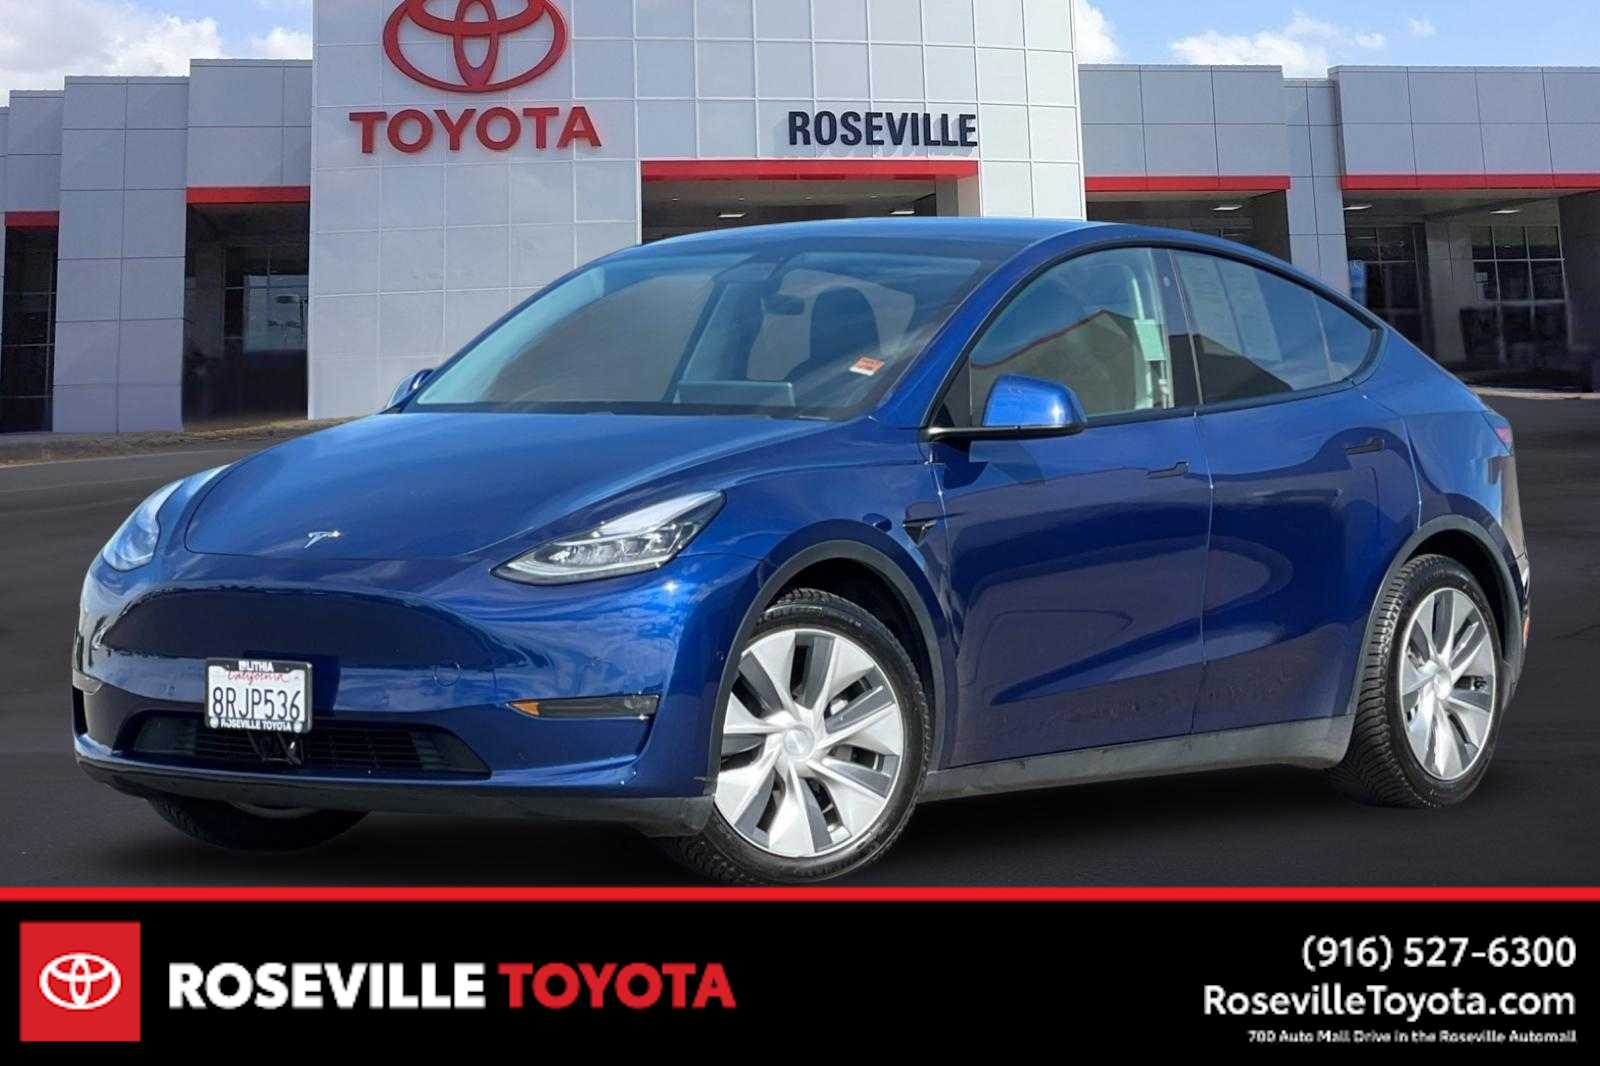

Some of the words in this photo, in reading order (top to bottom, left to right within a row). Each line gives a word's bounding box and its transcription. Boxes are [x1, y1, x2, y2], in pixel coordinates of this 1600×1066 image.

[350, 106, 602, 154] TOYOTA
[789, 111, 978, 147] ROSEVILLE
[247, 660, 274, 672] LITHIA
[212, 686, 301, 721] 8RJP536
[262, 720, 292, 731] TOYOTA
